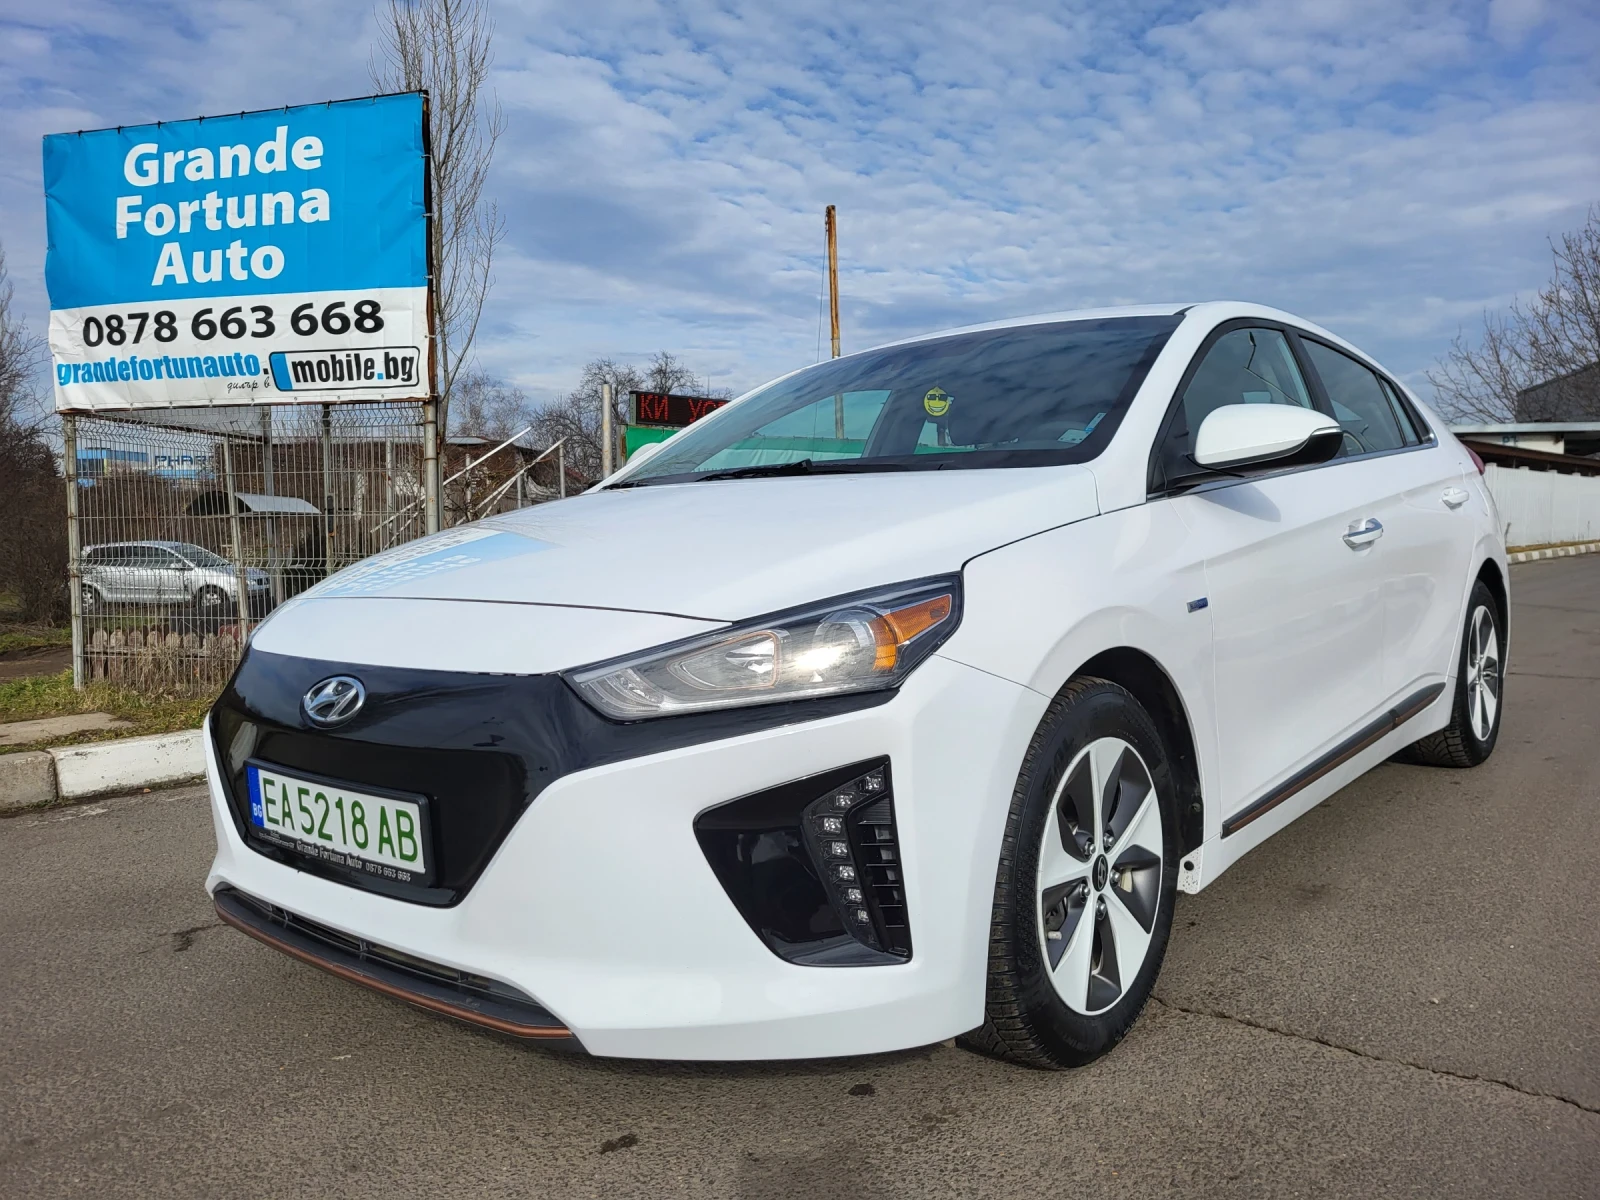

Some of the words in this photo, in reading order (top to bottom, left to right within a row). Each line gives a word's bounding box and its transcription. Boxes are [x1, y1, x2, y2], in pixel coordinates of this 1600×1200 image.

[124, 125, 324, 187] Grande
[116, 188, 330, 239] Fortuna
[151, 240, 285, 286] Auto
[83, 310, 179, 347] 0878
[191, 305, 276, 340] 663
[290, 299, 385, 336] 668
[291, 351, 415, 383] mobile.bg
[253, 803, 262, 817] BG
[378, 805, 418, 862] AB
[296, 841, 319, 856] Grande
[320, 848, 345, 864] Fortuna
[346, 854, 363, 869] Auto
